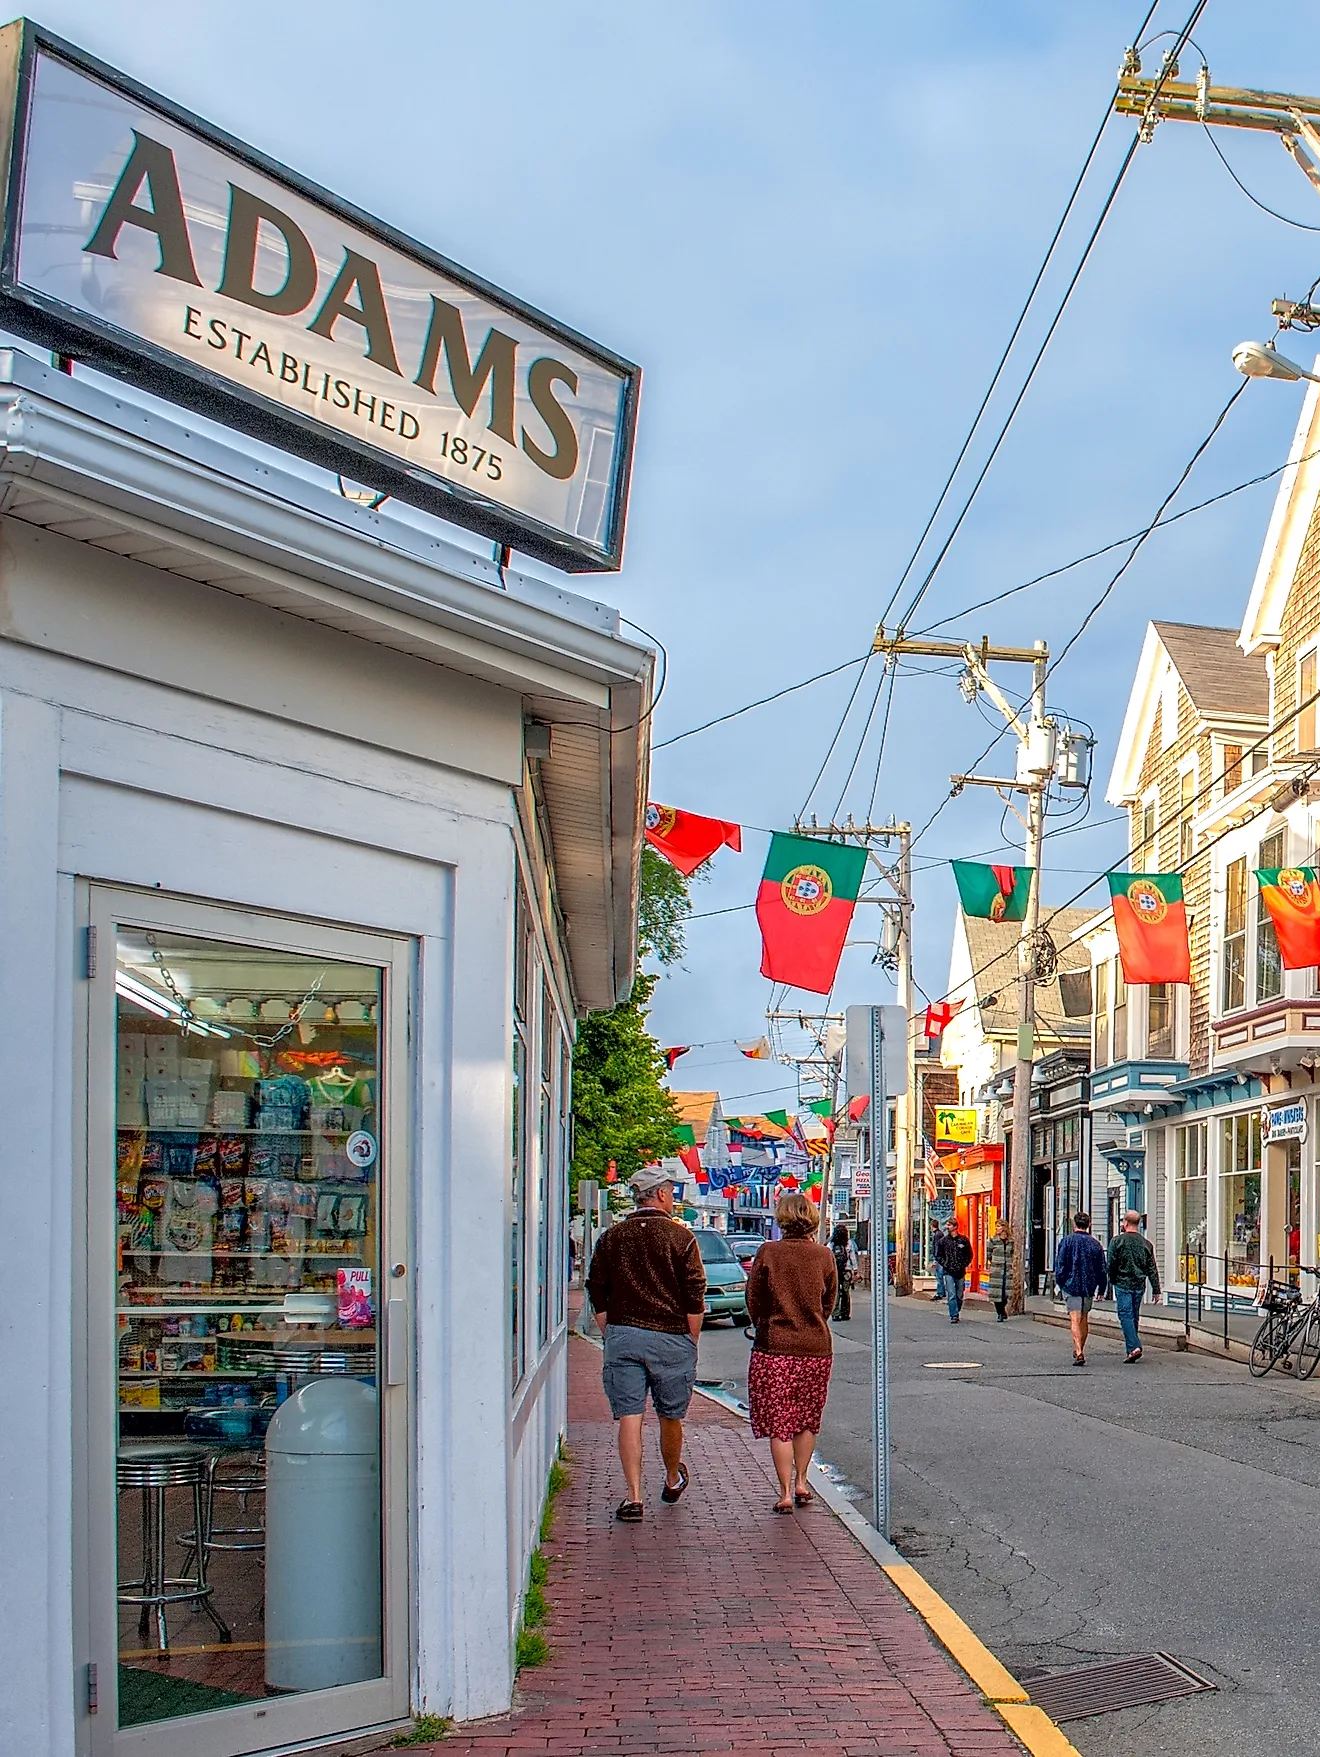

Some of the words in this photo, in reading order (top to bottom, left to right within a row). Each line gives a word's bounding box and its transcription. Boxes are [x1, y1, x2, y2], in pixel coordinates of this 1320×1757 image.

[82, 127, 580, 481] ADAMS
[183, 305, 421, 440] ESTABLISHED
[440, 431, 503, 482] 1875
[350, 1271, 370, 1282] PULL
